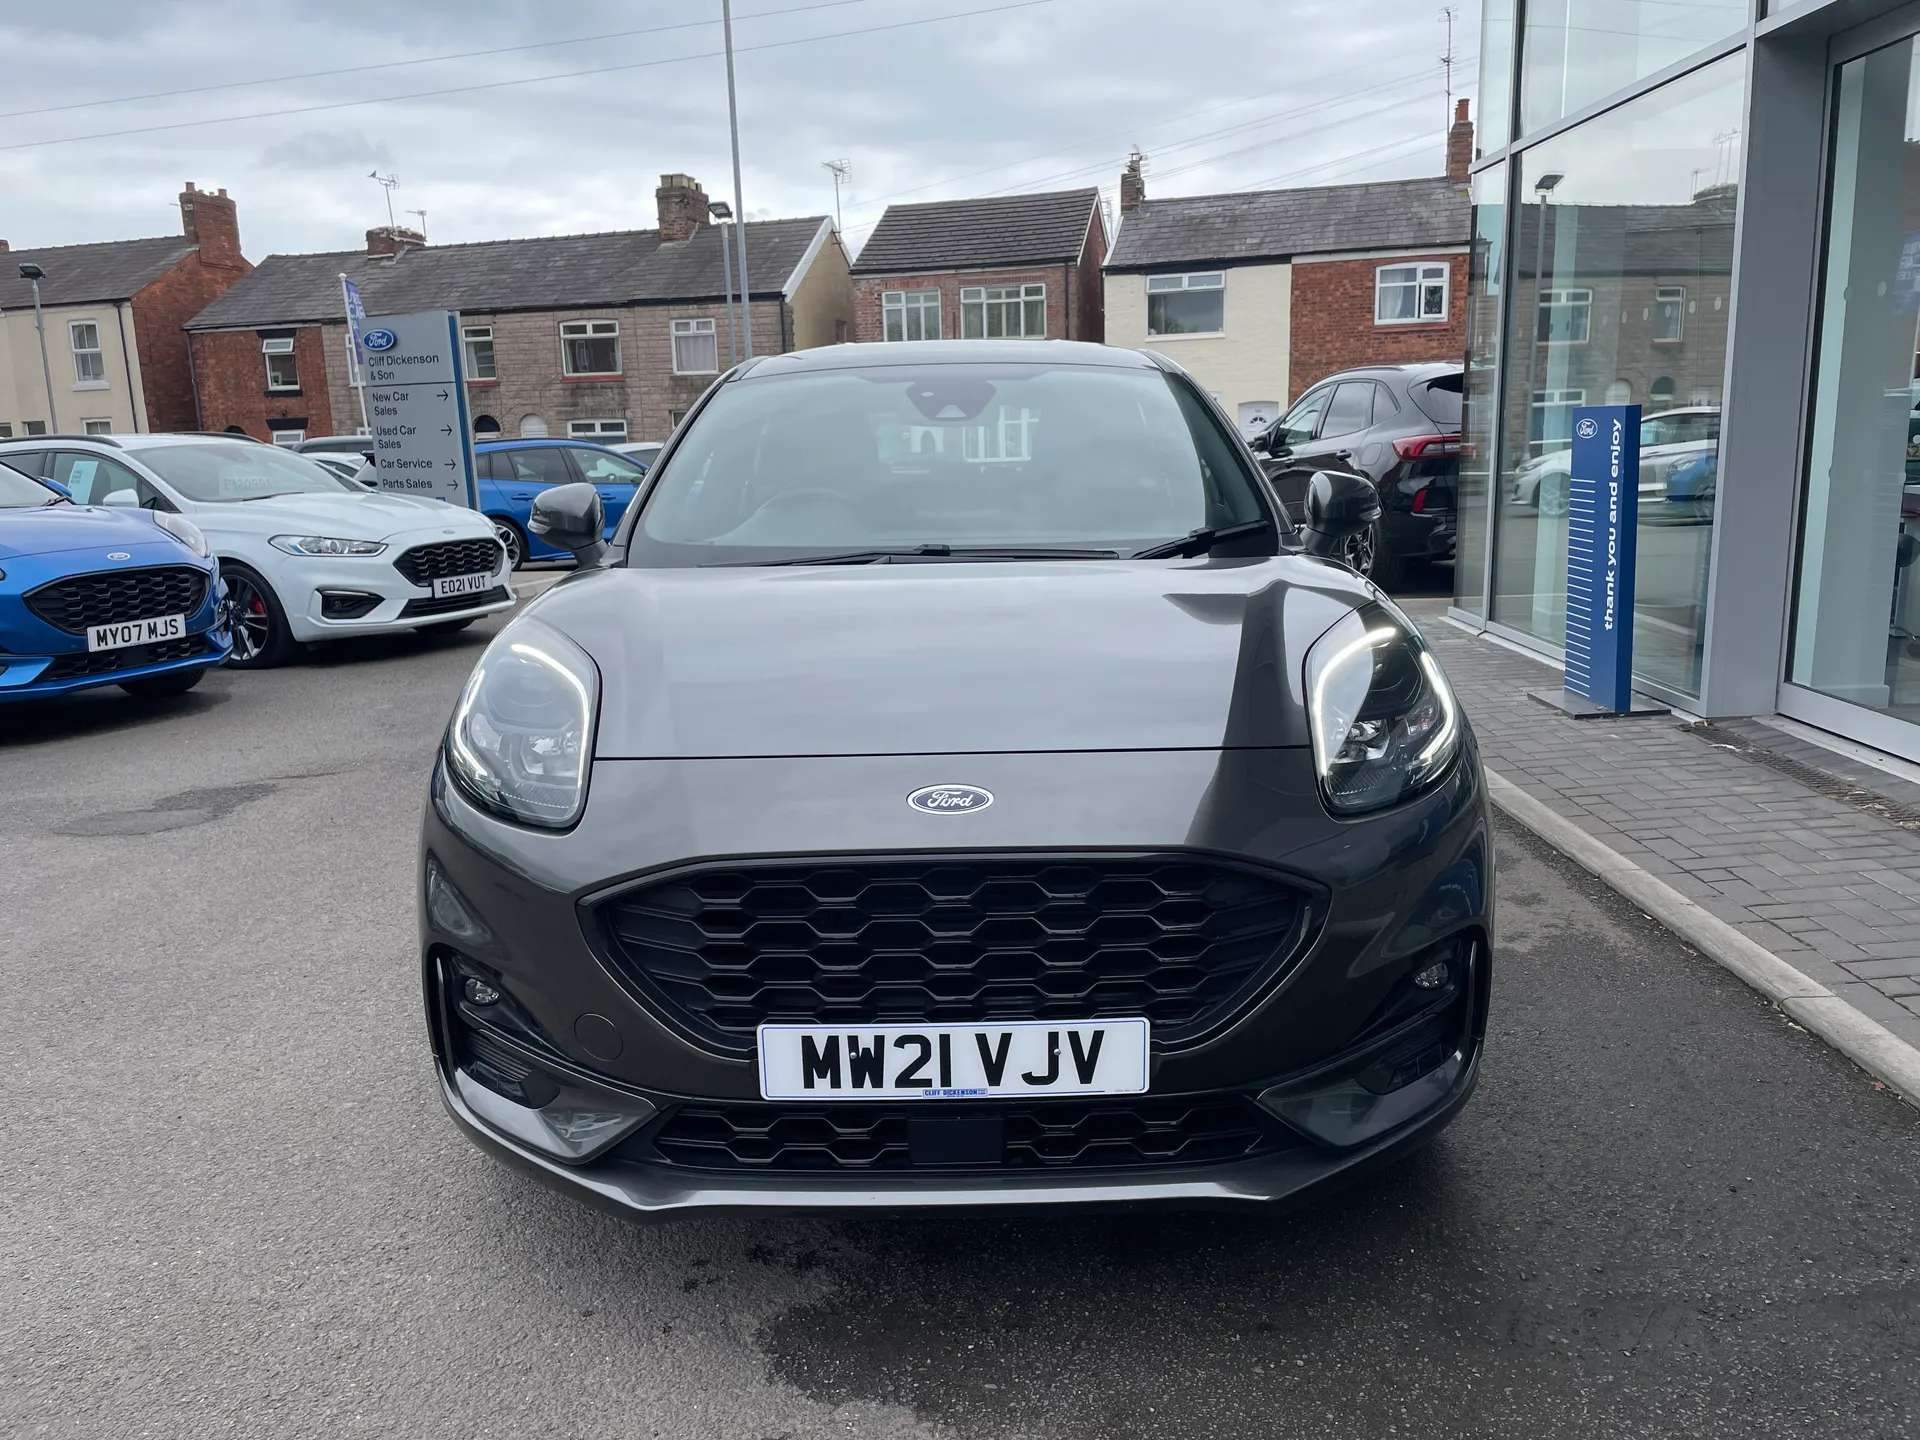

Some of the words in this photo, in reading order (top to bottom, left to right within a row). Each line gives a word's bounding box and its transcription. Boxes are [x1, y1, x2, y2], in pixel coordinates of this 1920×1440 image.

[368, 356, 385, 368] Cliff
[386, 354, 439, 367] Dickenson
[370, 371, 377, 381] &
[377, 369, 395, 381] Son
[372, 392, 391, 402] New
[392, 391, 409, 402] Car
[374, 406, 398, 416] Sales
[376, 426, 398, 436] Used
[399, 425, 417, 436] Car
[378, 439, 402, 449] Sales
[1610, 418, 1622, 478] enjoy
[380, 458, 395, 469] Car
[396, 458, 433, 469] Service
[382, 478, 405, 489] Parts
[405, 478, 433, 489] Sales
[1608, 482, 1618, 524] and
[1607, 527, 1617, 566] you
[467, 575, 486, 590] VUT
[1604, 569, 1615, 631] thank
[96, 625, 143, 647] MY07
[147, 619, 179, 640] MJS
[801, 1033, 952, 1089] MW21
[974, 1030, 1105, 1087] VJV
